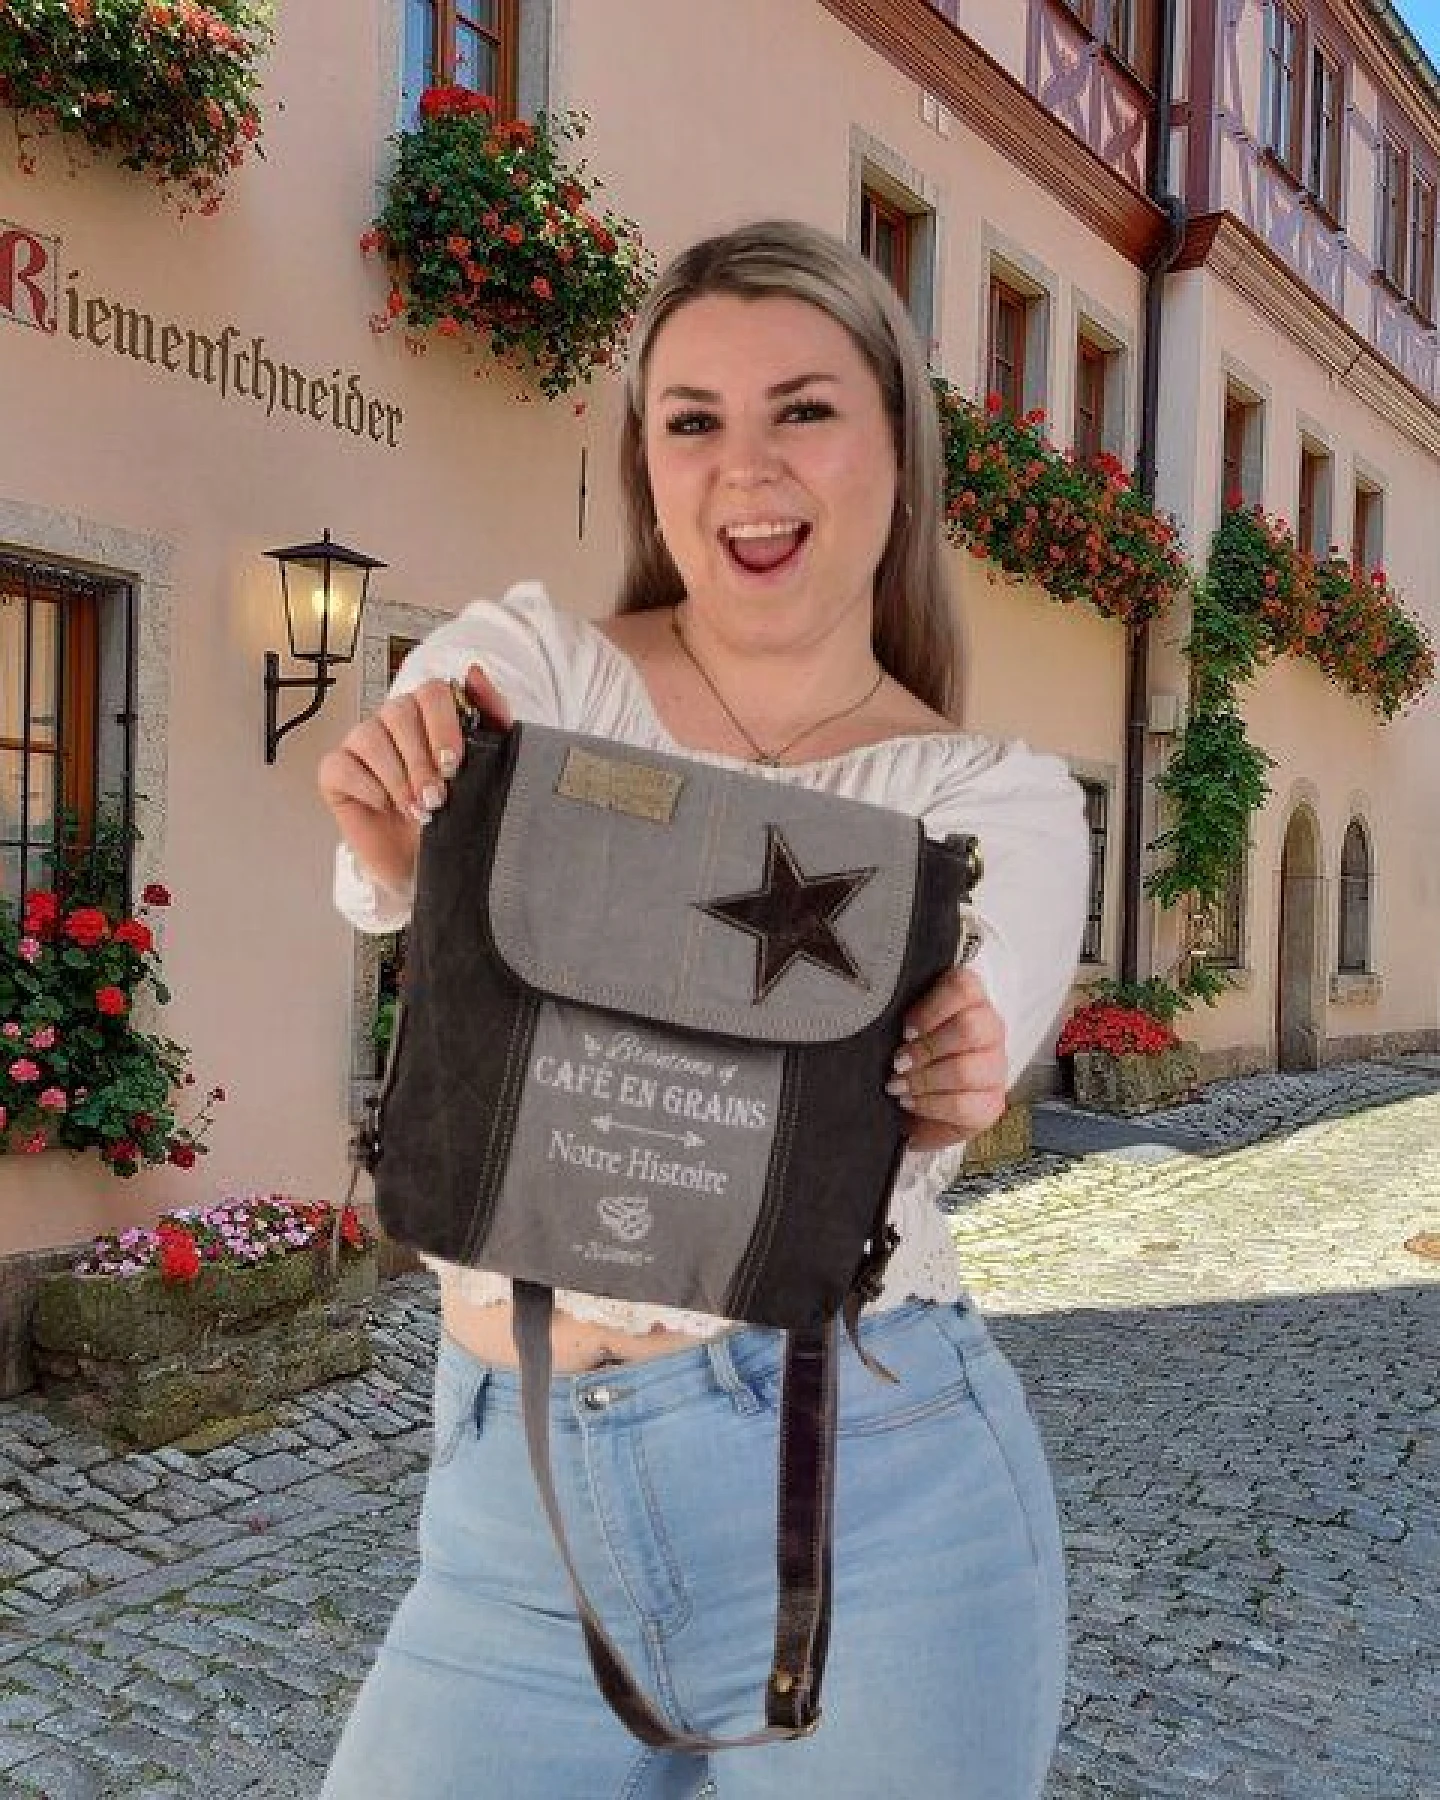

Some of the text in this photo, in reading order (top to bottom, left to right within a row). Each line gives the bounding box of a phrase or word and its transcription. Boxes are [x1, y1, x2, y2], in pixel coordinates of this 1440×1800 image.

[535, 1055, 766, 1128] CAFÉ EN GRAINS
[549, 1129, 729, 1195] Notre Histoire
